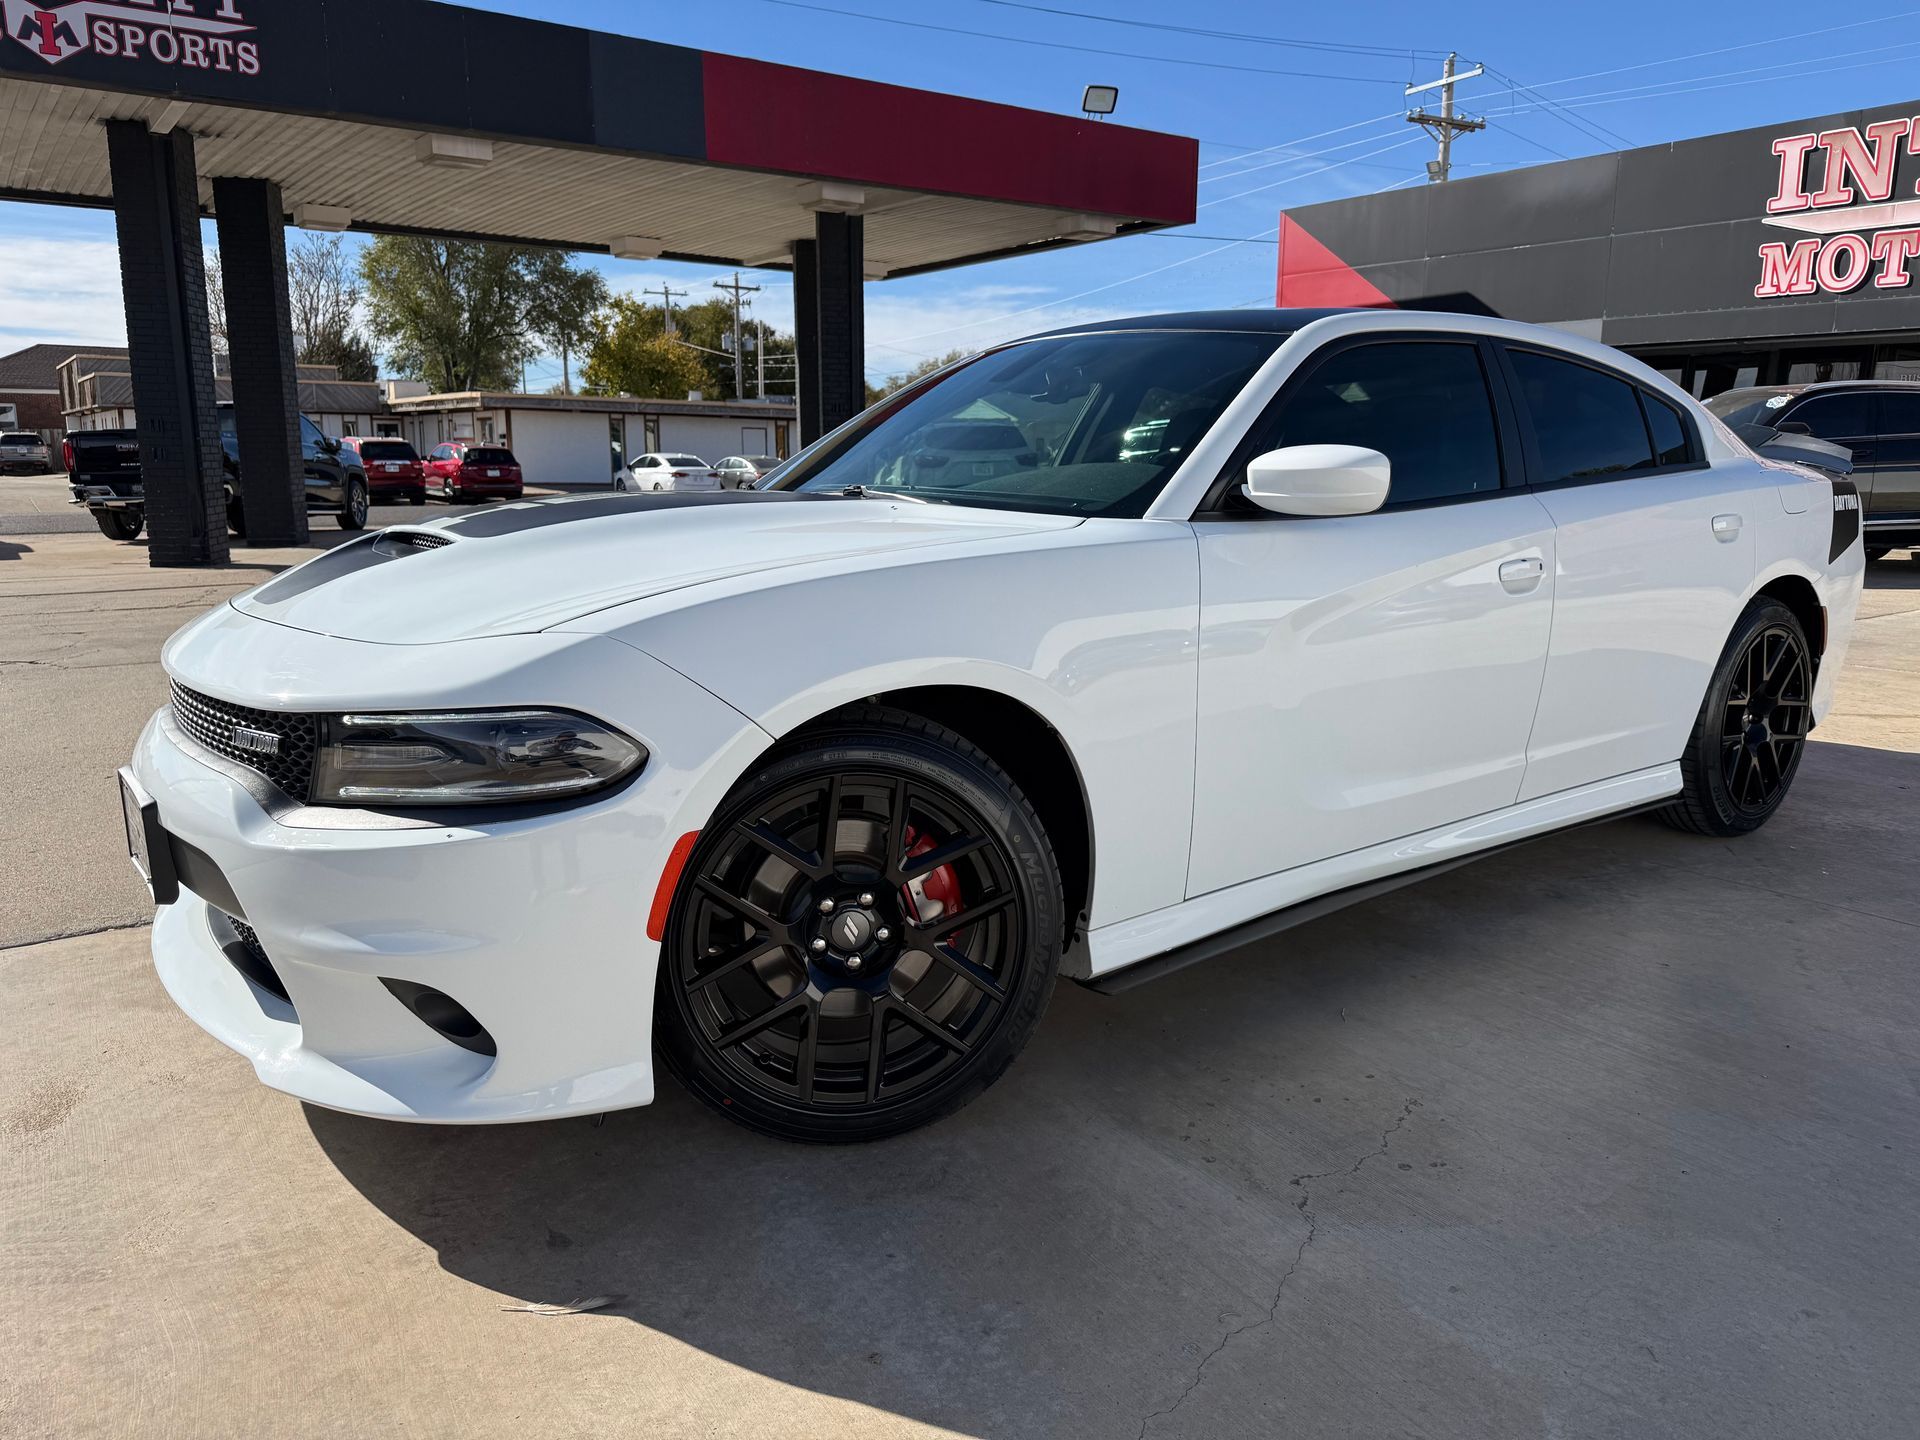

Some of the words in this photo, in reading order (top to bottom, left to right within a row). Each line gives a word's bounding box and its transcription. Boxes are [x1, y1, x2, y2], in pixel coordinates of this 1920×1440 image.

[92, 20, 261, 75] SPORTS
[1834, 494, 1858, 511] DAYTONA
[234, 729, 278, 754] DAYTONA
